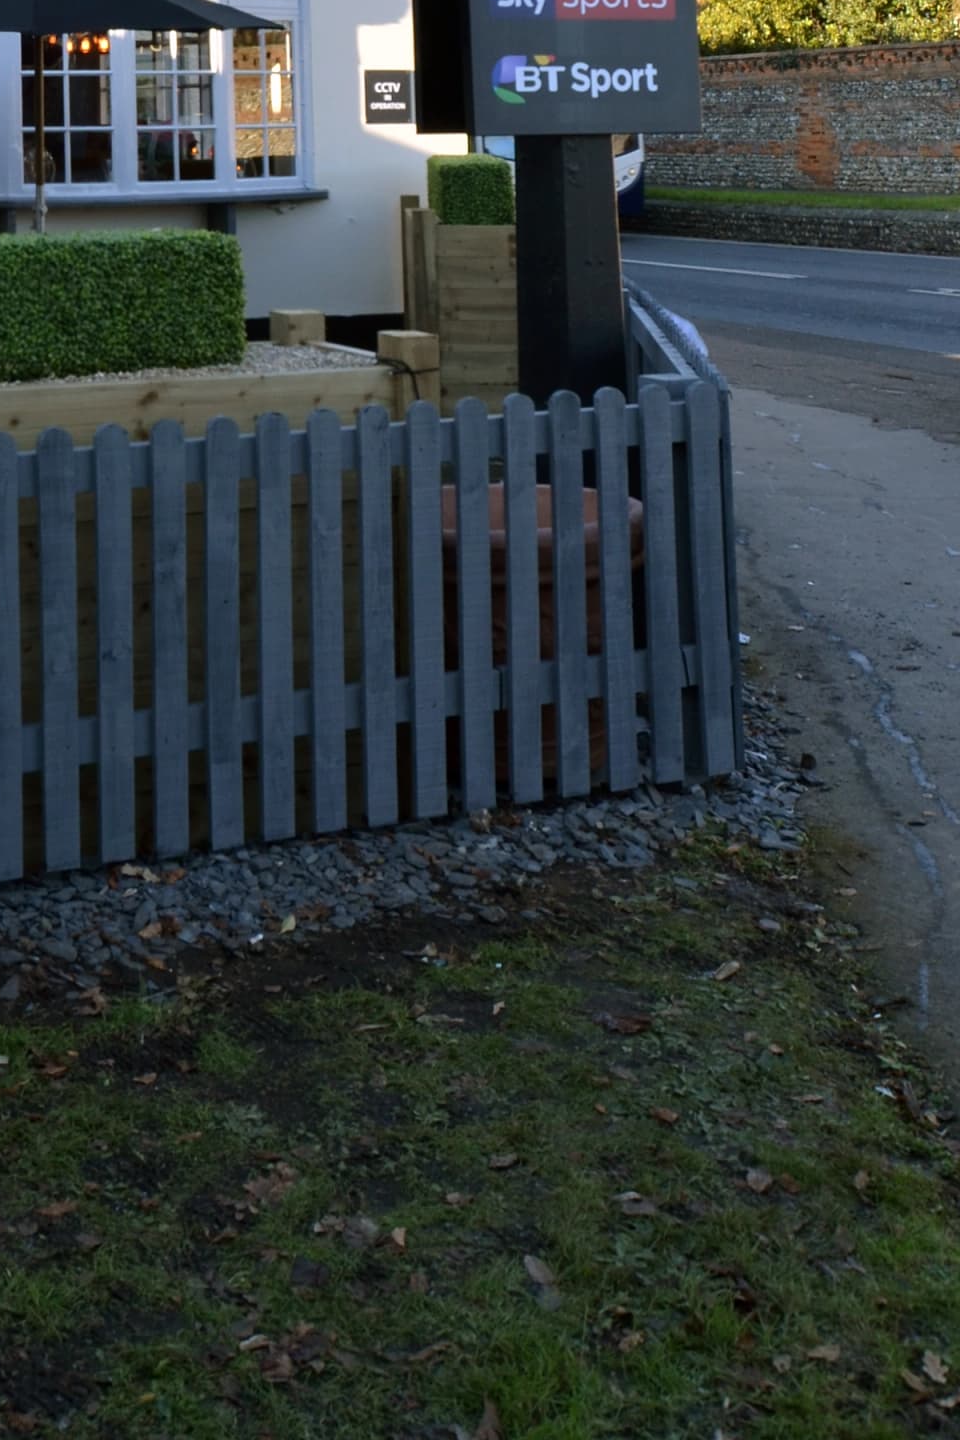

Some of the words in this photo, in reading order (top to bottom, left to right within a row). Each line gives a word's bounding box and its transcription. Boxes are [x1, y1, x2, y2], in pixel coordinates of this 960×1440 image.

[374, 82, 401, 93] CCTV
[514, 65, 566, 92] BT
[570, 62, 659, 98] Sport
